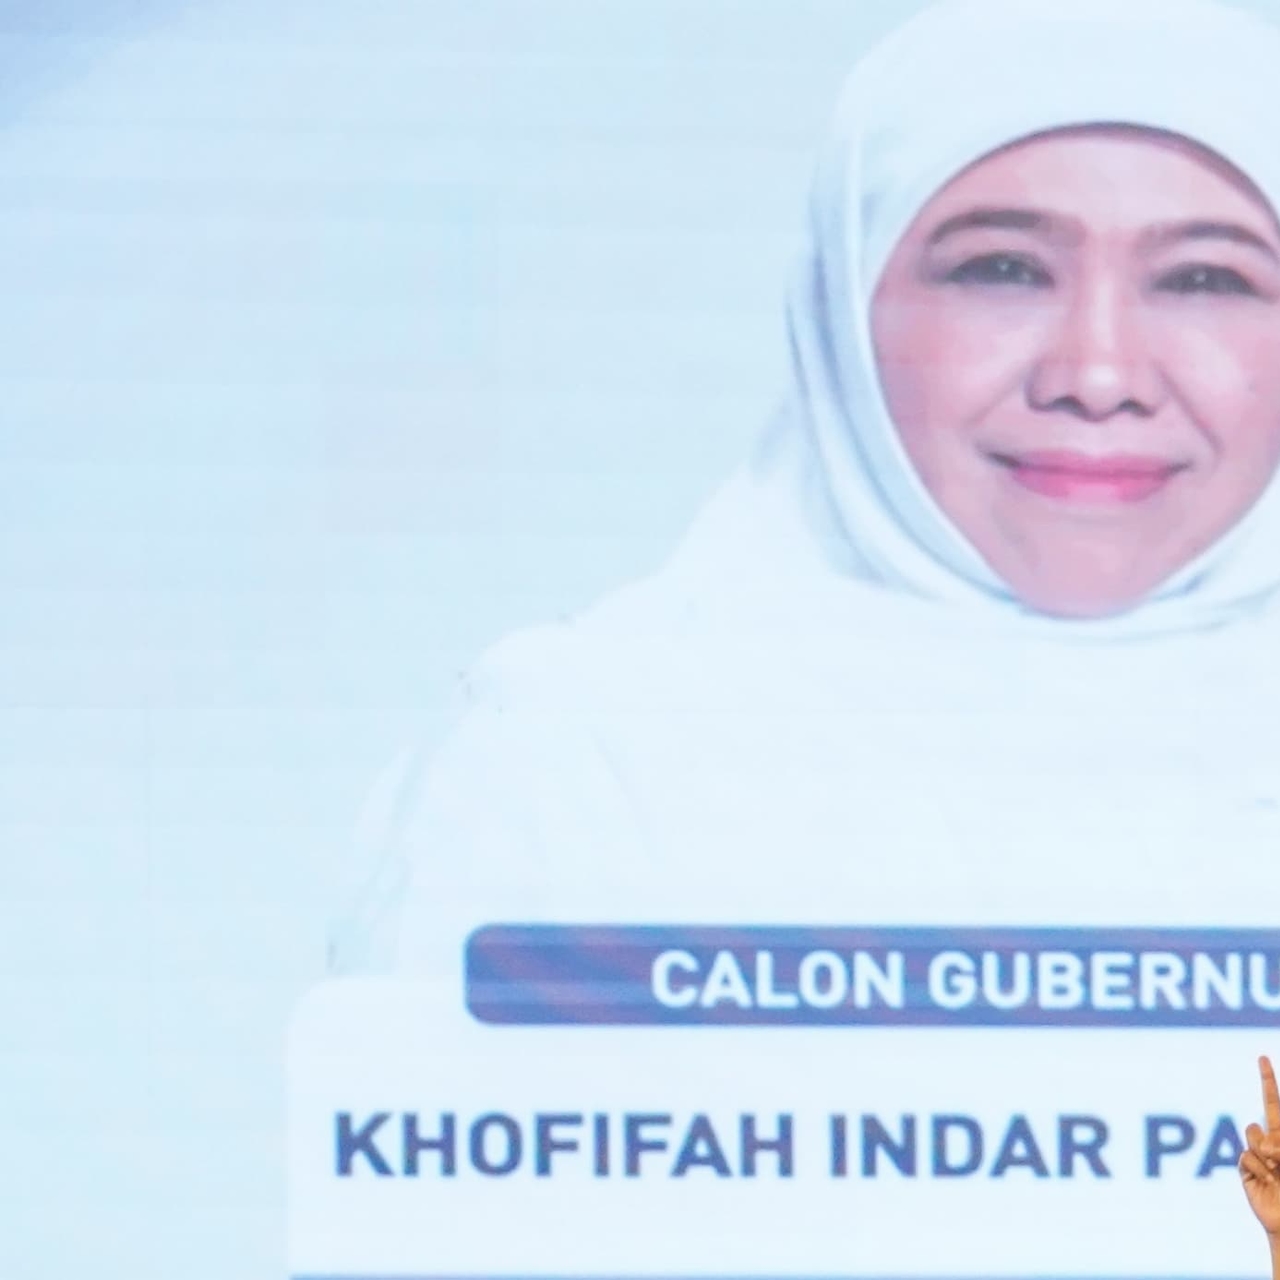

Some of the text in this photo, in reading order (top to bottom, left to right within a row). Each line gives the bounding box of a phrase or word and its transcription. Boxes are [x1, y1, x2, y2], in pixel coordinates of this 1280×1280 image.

[651, 950, 905, 1009] CALON
[335, 1112, 794, 1178] KHOFIFAH
[829, 1113, 1112, 1179] INDAR
